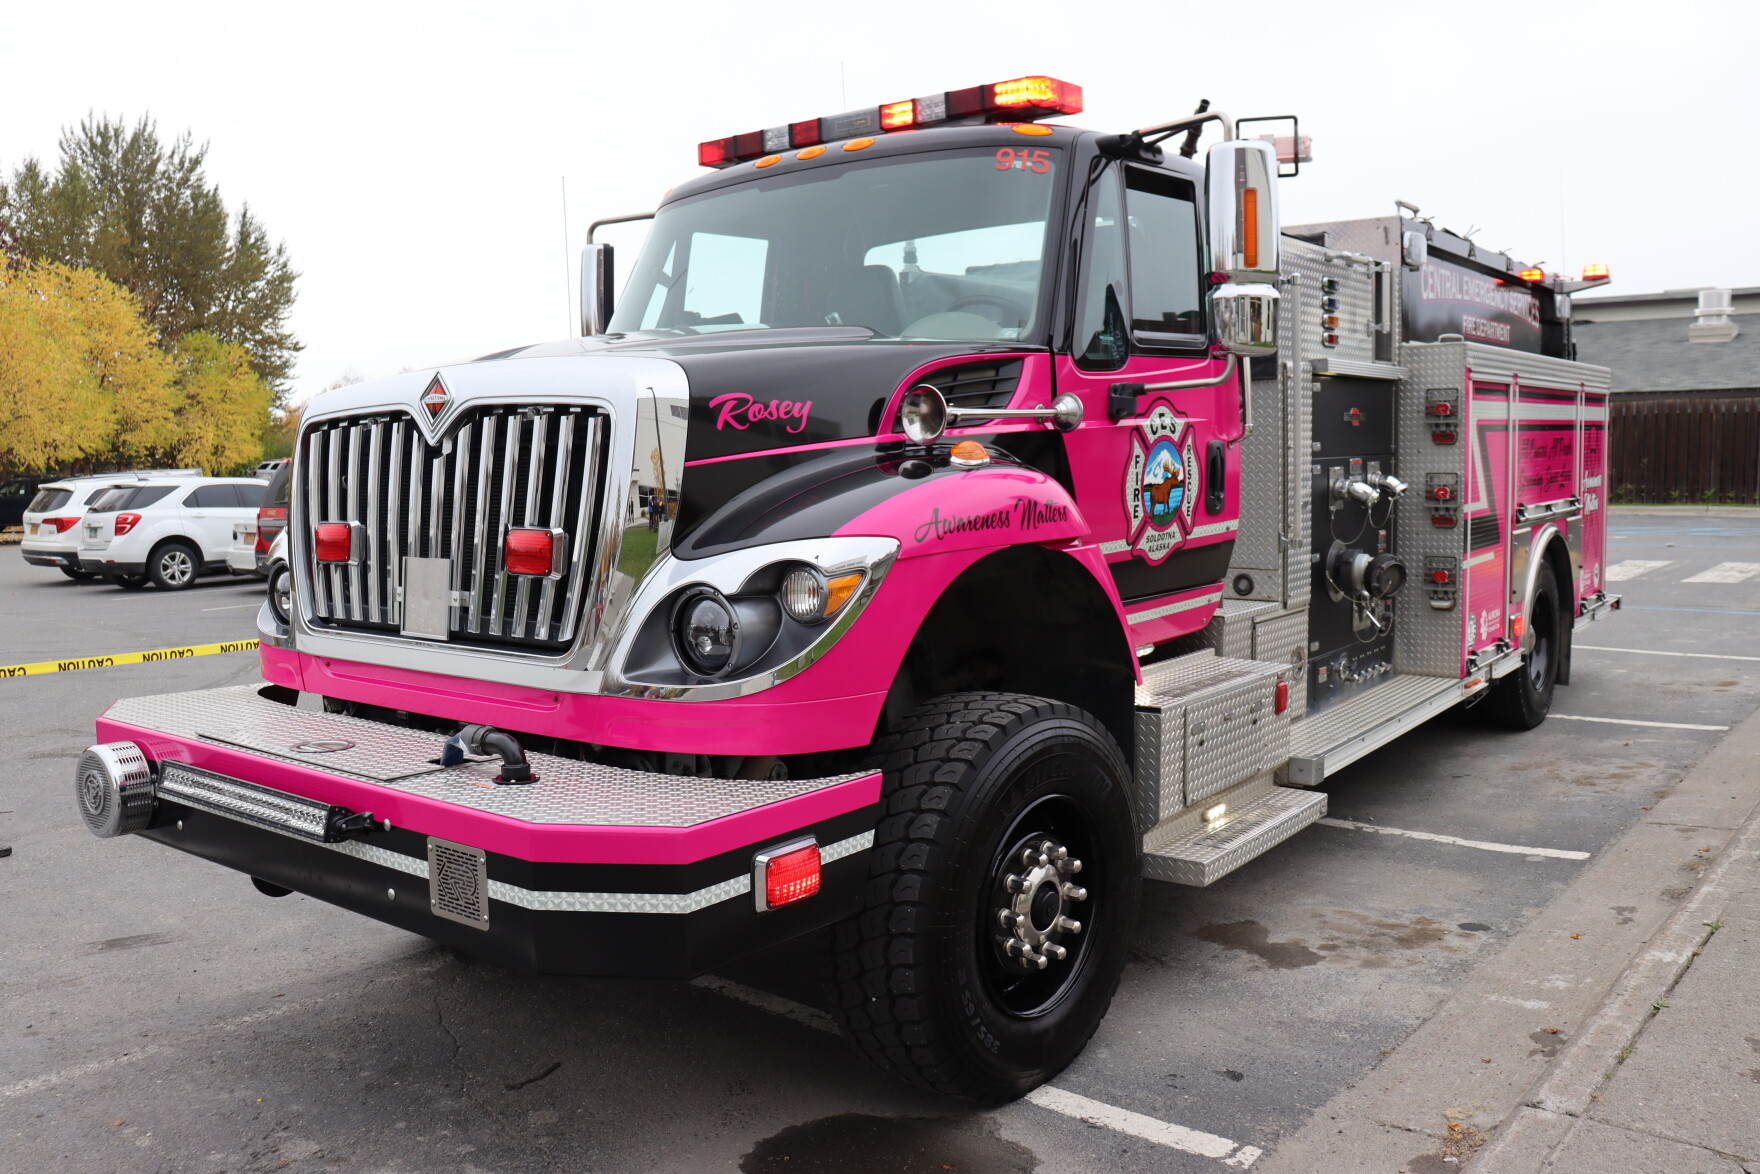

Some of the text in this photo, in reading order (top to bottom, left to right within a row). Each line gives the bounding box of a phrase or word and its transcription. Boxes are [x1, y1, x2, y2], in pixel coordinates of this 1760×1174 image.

[995, 147, 1050, 174] 915
[1421, 264, 1540, 329] CENTRAL EMERGENCY SERVICES
[708, 392, 813, 434] Rosey
[1150, 413, 1177, 435] CES
[1133, 455, 1141, 519] FIRE
[914, 498, 1068, 543] Awareness Matters
[1146, 531, 1176, 544] SOLDOTNA
[1148, 543, 1170, 553] ALASKA
[58, 657, 114, 672] CAUTION
[142, 648, 194, 662] CAUTION
